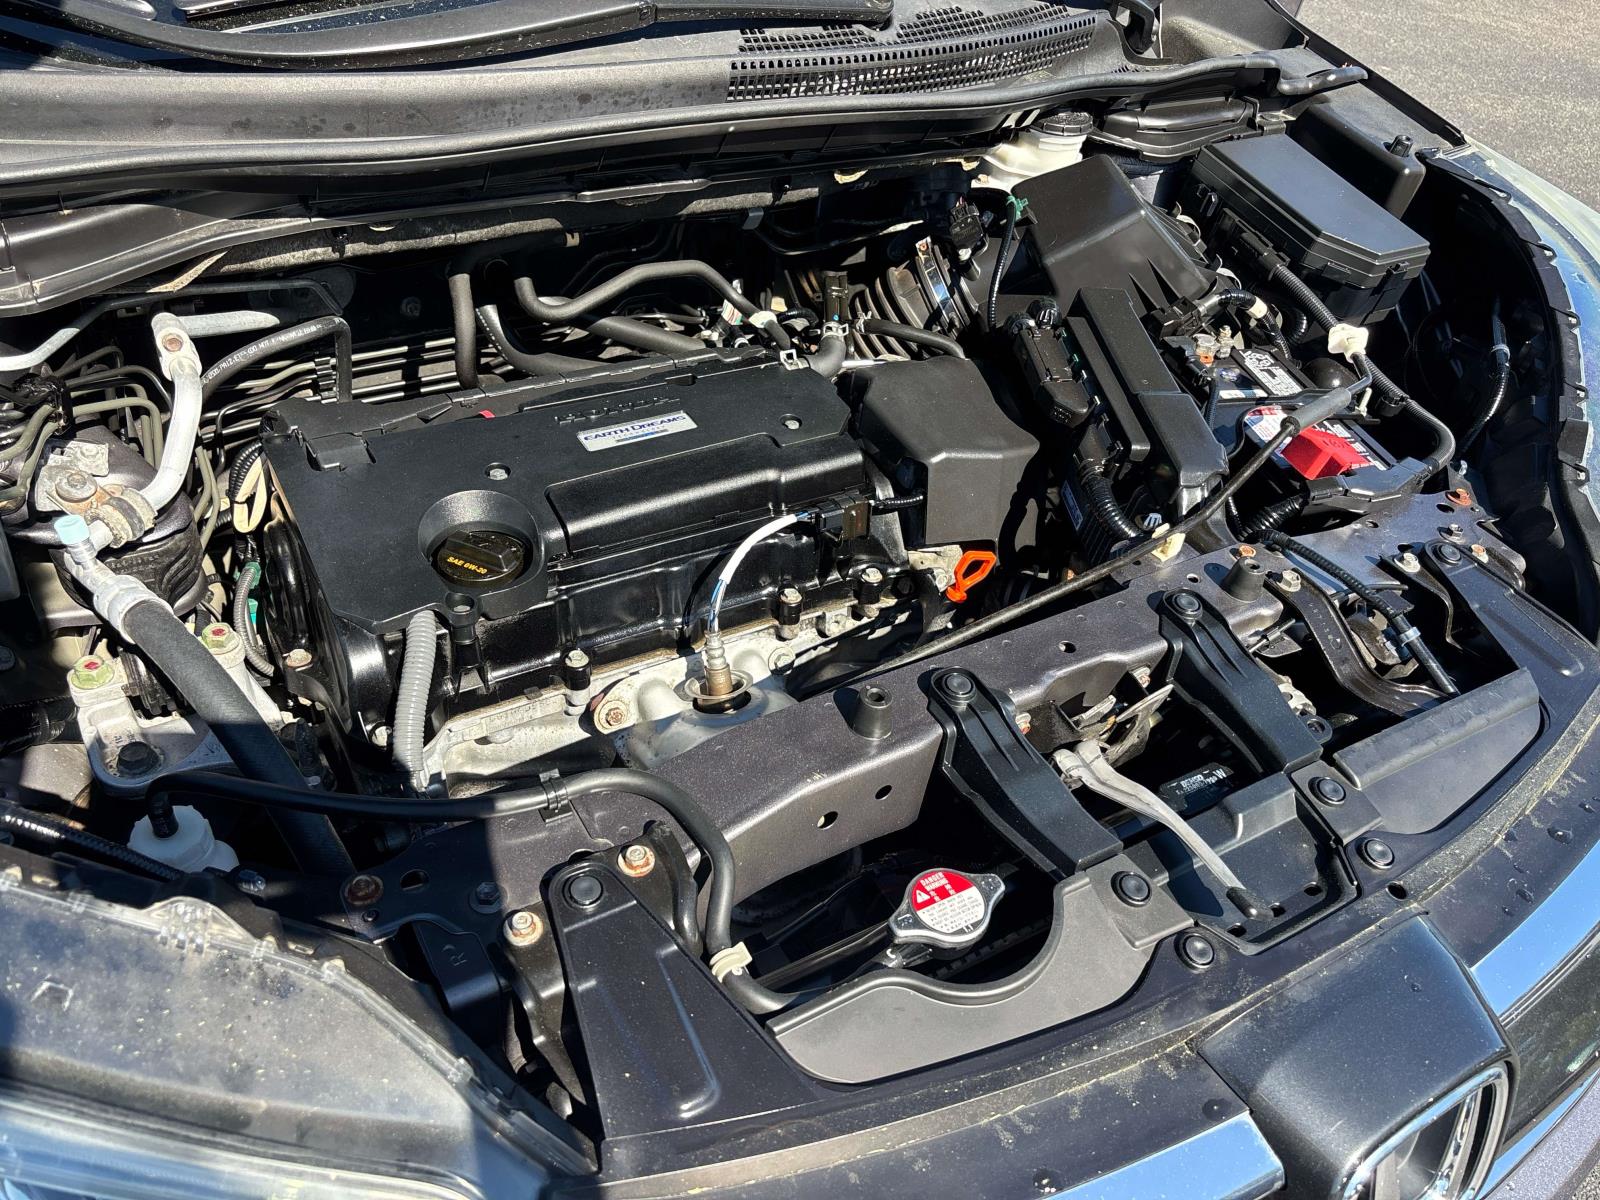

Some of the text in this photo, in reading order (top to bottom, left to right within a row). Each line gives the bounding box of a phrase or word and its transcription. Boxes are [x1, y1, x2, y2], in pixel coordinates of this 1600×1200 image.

[583, 415, 686, 441] EARTH DREAMS
[447, 556, 488, 575] SAE 0W-20
[920, 871, 944, 886] DANGER
